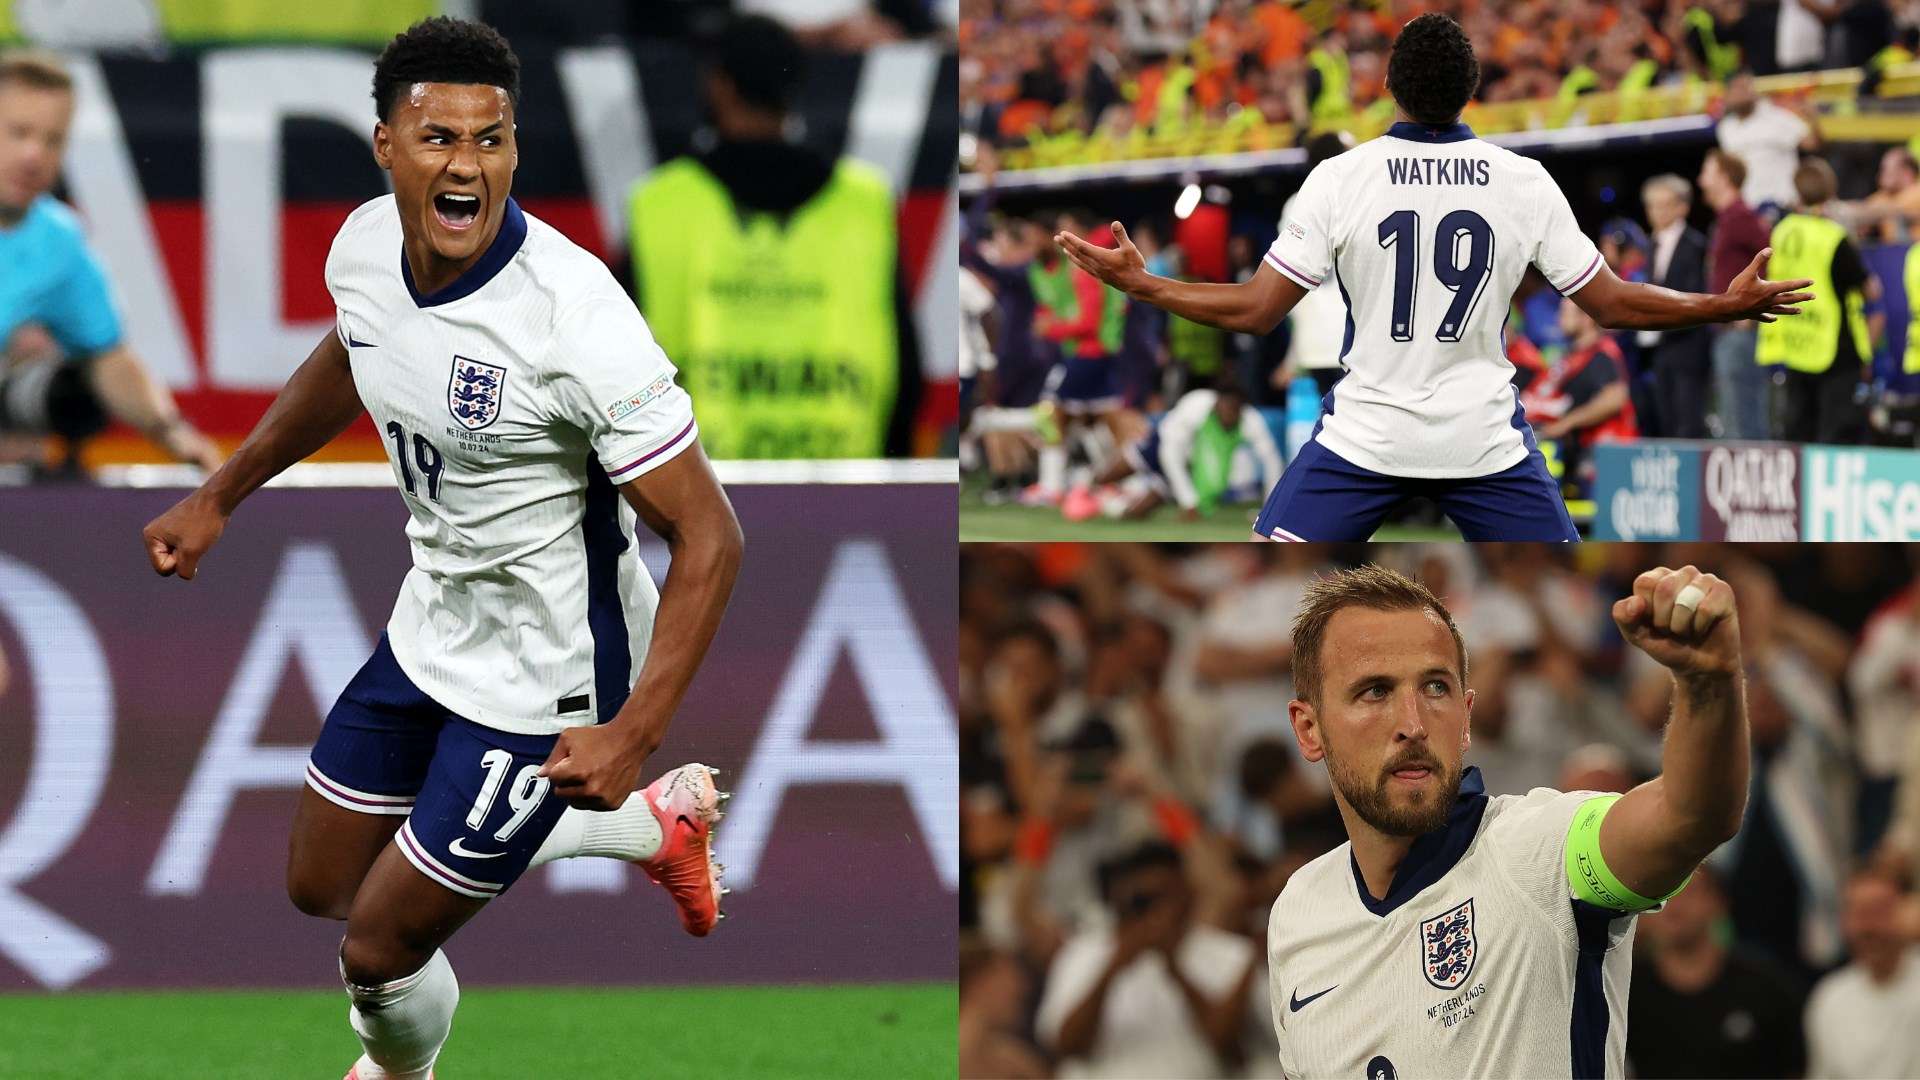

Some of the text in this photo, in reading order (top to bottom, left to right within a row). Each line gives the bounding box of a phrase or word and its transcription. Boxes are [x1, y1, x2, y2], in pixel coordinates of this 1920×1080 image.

[1387, 157, 1490, 186] WATKINS
[1378, 209, 1495, 342] 19
[609, 375, 669, 420] FOUNDATION
[446, 427, 501, 444] NETHERLANDS
[458, 441, 489, 453] 10.07.24
[387, 420, 445, 504] 19
[1706, 446, 1797, 521] QATAR
[466, 749, 550, 842] 19
[1577, 852, 1632, 910] ESPECT
[1427, 983, 1486, 1019] NETHERLANDS
[1441, 1005, 1475, 1028] 10.07.24
